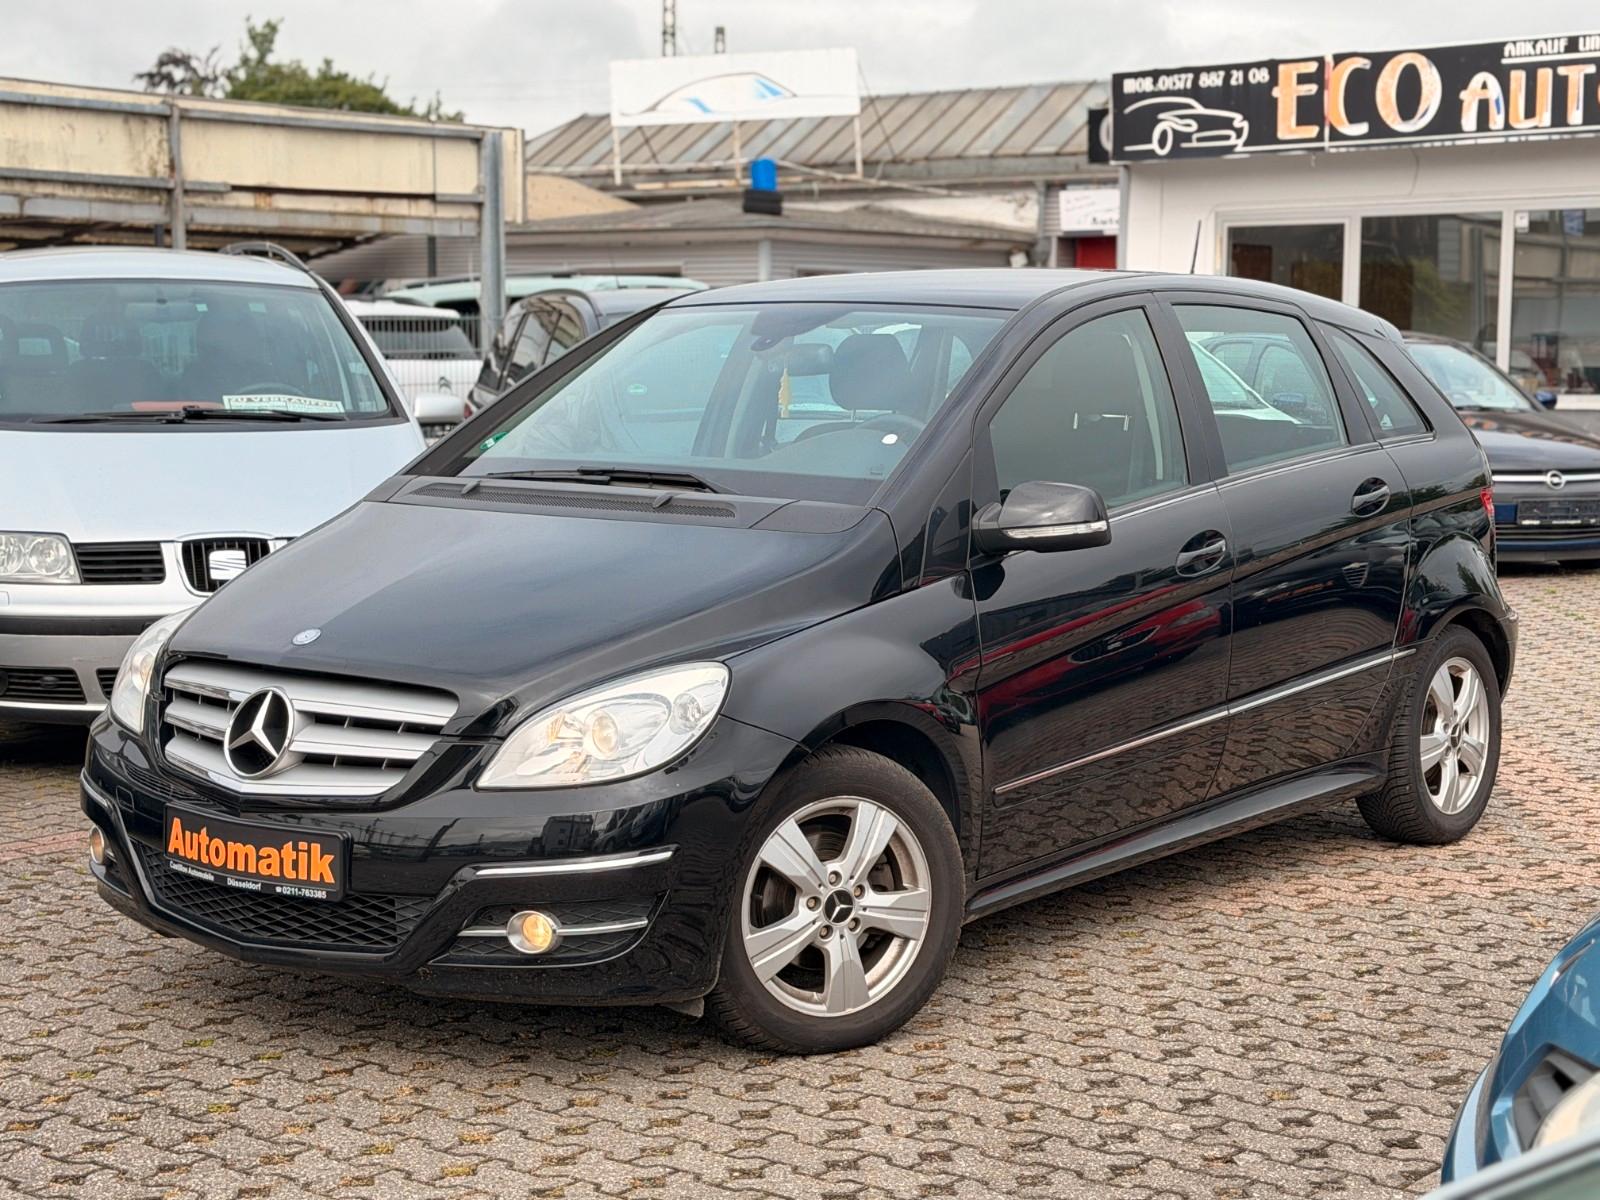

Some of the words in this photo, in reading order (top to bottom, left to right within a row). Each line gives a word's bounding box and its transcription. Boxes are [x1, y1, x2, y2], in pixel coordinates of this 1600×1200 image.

[1503, 38, 1568, 58] ANKAUF
[1199, 70, 1225, 88] 887
[1230, 68, 1244, 86] 21
[1248, 66, 1270, 84] 08
[1271, 52, 1443, 141] ECO
[1459, 63, 1600, 132] AUT
[168, 817, 336, 884] Automatik
[226, 877, 262, 892] Düsseldorf
